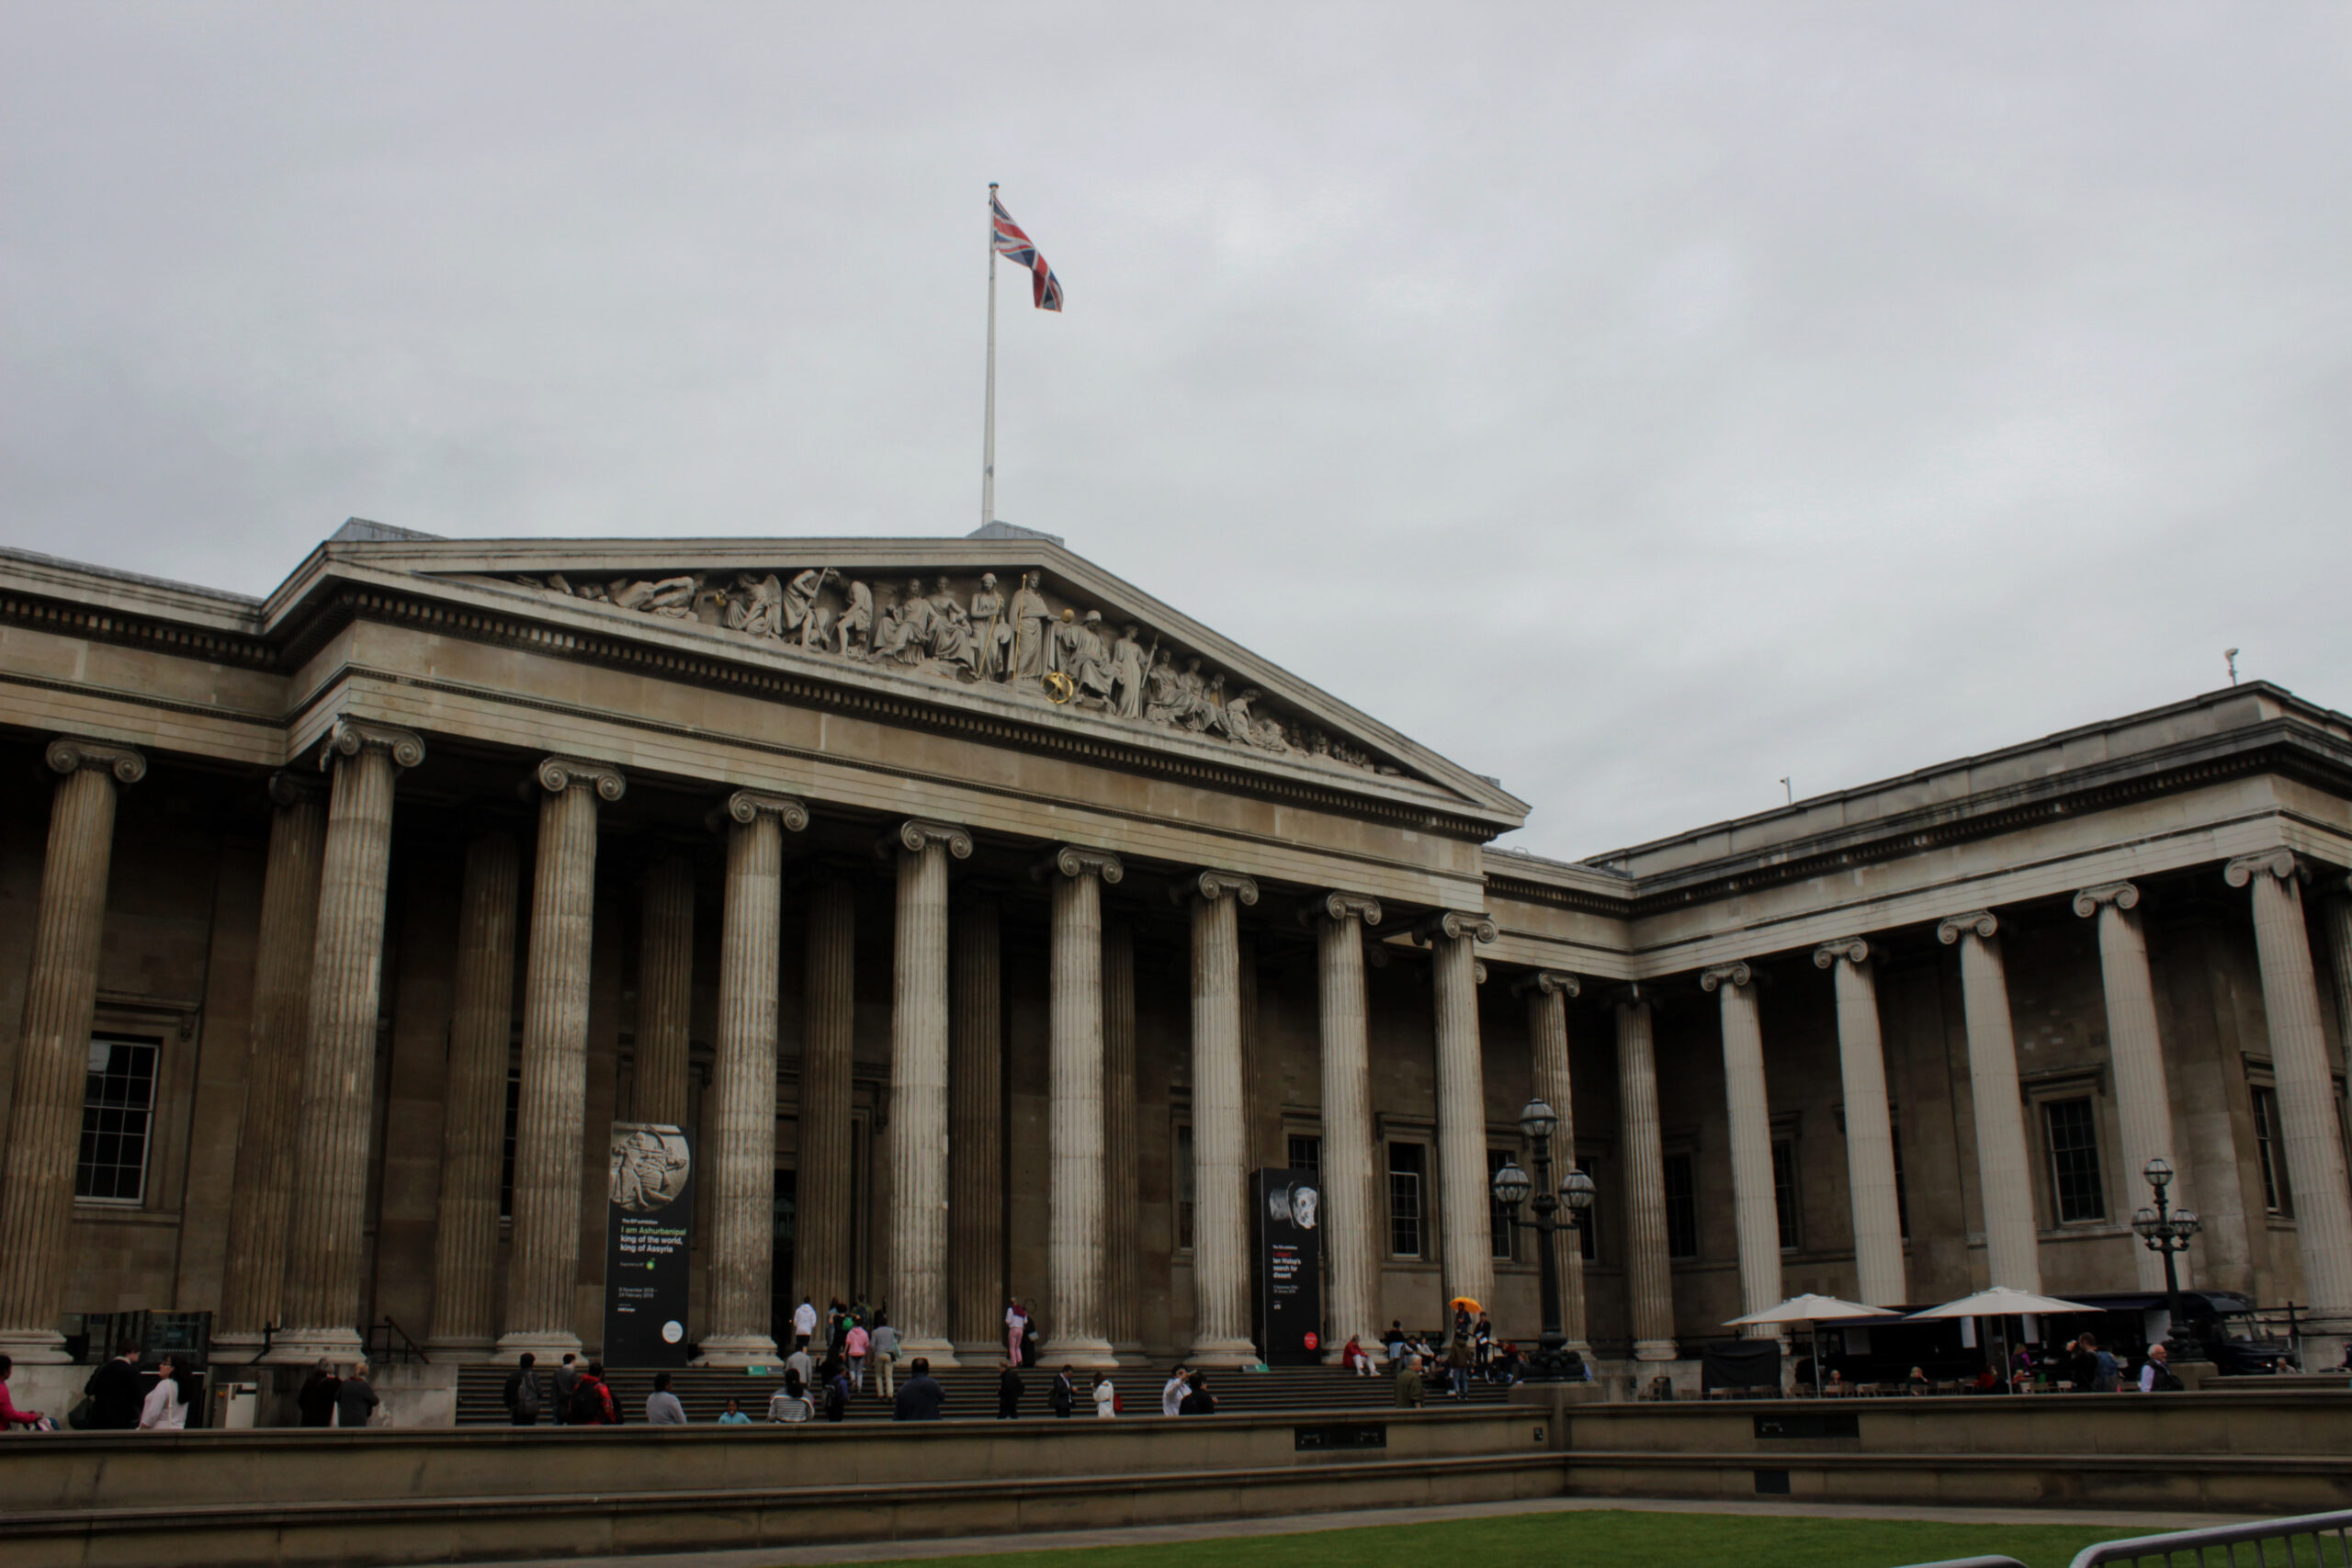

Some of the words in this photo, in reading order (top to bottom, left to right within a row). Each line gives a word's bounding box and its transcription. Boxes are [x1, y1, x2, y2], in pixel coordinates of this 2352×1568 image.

[639, 1226, 686, 1236] Ashurbanipal
[620, 1235, 637, 1244] king
[638, 1235, 647, 1243] of
[647, 1235, 660, 1244] the
[661, 1236, 683, 1246] world,
[620, 1244, 637, 1253] king
[638, 1244, 646, 1252] of
[646, 1245, 673, 1254] Assyria
